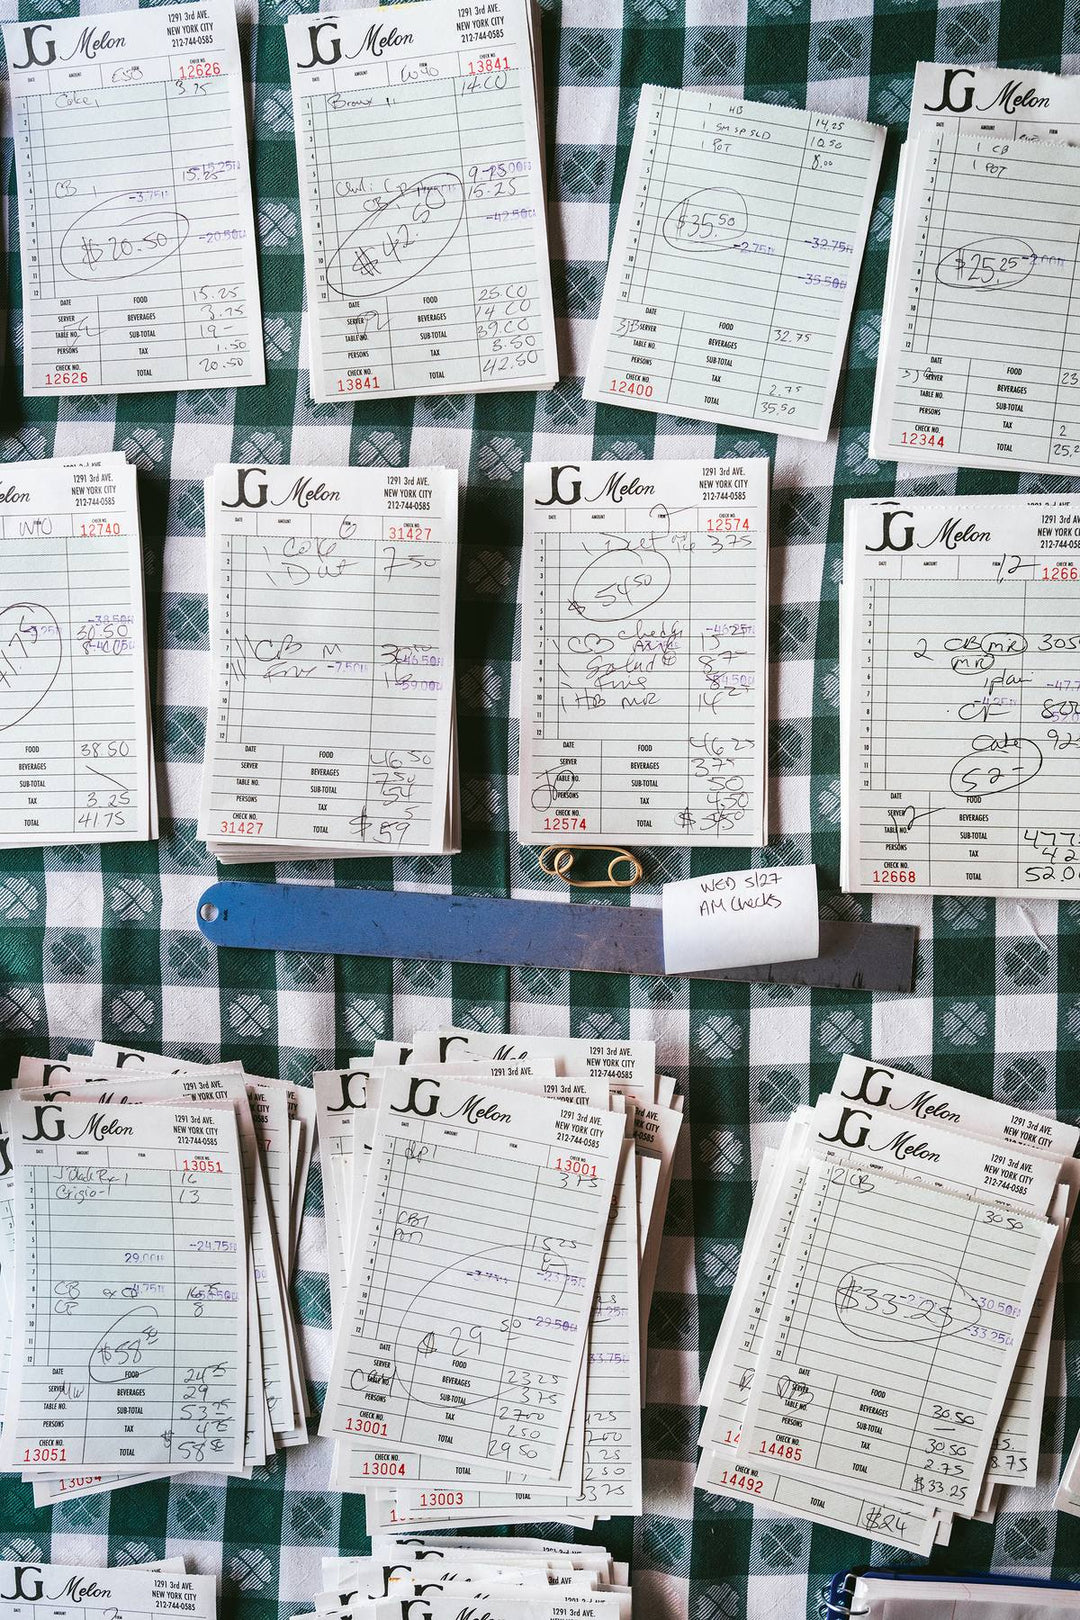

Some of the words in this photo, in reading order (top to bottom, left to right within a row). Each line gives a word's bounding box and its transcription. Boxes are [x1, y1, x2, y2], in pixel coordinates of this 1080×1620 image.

[168, 13, 182, 23] 1291
[184, 11, 195, 21] 3rd
[197, 10, 210, 19] AVE.
[458, 8, 472, 17] 1291
[475, 5, 485, 15] 3rd
[488, 4, 500, 13] AVE.
[167, 26, 180, 36] NEW
[182, 24, 199, 34] YORK
[200, 22, 213, 32] CITY
[456, 21, 470, 31] NEW
[472, 18, 489, 28] YORK
[491, 16, 504, 26] CITY
[172, 35, 213, 48] 212-744-0585
[461, 29, 504, 43] 212-744-0585
[13, 24, 56, 69] JG
[60, 27, 126, 61] Melon
[297, 23, 342, 68] JG
[345, 24, 414, 59] Melon
[179, 63, 221, 78] 12626
[468, 58, 510, 75] 13841
[924, 69, 976, 113] JG
[976, 80, 1050, 114] Melon
[134, 296, 148, 304] FOOD
[128, 313, 156, 322] BEVERAGES
[646, 307, 657, 315] DATE
[640, 322, 657, 332] SERVER
[719, 322, 734, 331] FOOD
[129, 330, 156, 338] SUB-TOTAL
[633, 339, 647, 348] TABLE
[708, 338, 737, 350] BEVERAGES
[631, 356, 652, 366] PERSONS
[706, 356, 732, 367] SUB-TOTAL
[45, 372, 88, 385] 12626
[626, 373, 641, 381] CHECK
[712, 374, 722, 382] TAX
[337, 377, 380, 393] 13841
[609, 380, 653, 398] 12400
[704, 396, 719, 405] TOTAL
[900, 432, 945, 448] 12344
[997, 443, 1012, 452] TOTAL
[74, 474, 87, 483] 1291
[90, 474, 99, 482] 3rd
[102, 473, 114, 482] AVE.
[703, 468, 716, 476] 1291
[720, 467, 730, 476] 3rd
[732, 467, 745, 476] AVE.
[222, 468, 268, 508] JG
[271, 476, 340, 508] Melon
[388, 476, 401, 484] 1291
[404, 477, 414, 486] 3rd
[416, 477, 429, 486] AVE.
[535, 465, 582, 506] JG
[584, 472, 655, 503] Melon
[699, 480, 714, 489] NEW
[715, 480, 732, 488] YORK
[734, 480, 748, 488] CITY
[72, 487, 85, 495] NEW
[86, 486, 102, 494] YORK
[104, 486, 116, 494] CITY
[384, 489, 398, 497] NEW
[400, 489, 416, 498] YORK
[419, 490, 432, 498] CITY
[703, 492, 746, 500] 212-744-0585
[76, 497, 115, 506] 212-744-0585
[388, 501, 430, 510] 212-744-0585
[81, 523, 120, 537] 12740
[707, 519, 749, 531] 12574
[865, 510, 915, 552] JG
[917, 518, 991, 550] Melon
[389, 528, 432, 541] 31427
[220, 821, 263, 835] 31427
[313, 826, 328, 834] TOTAL
[544, 818, 587, 831] 12574
[873, 870, 916, 884] 12668
[700, 877, 737, 895] WED
[700, 898, 727, 916] AM
[390, 1078, 440, 1117] JG
[440, 1094, 511, 1124] Melon
[840, 1066, 894, 1107] JG
[889, 1091, 960, 1123] Melon
[22, 1105, 66, 1141] JG
[68, 1113, 134, 1141] Melon
[175, 1115, 188, 1123] 1291
[191, 1116, 201, 1124] 3rd
[561, 1110, 574, 1120] 1291
[577, 1113, 588, 1122] 3rd
[589, 1116, 602, 1126] AVE.
[173, 1126, 186, 1134] NEW
[188, 1126, 204, 1134] YORK
[555, 1121, 570, 1130] NEW
[572, 1124, 588, 1134] YORK
[590, 1128, 604, 1138] CITY
[818, 1107, 872, 1148] JG
[868, 1131, 940, 1162] Melon
[178, 1136, 218, 1146] 212-744-0585
[557, 1132, 600, 1149] 212-744-0585
[183, 1159, 224, 1173] 13051
[556, 1157, 597, 1179] 13001
[991, 1154, 1006, 1164] 1291
[1008, 1159, 1020, 1169] 3rd
[1020, 1163, 1032, 1173] AVE.
[984, 1164, 1000, 1175] NEW
[1001, 1169, 1018, 1180] YORK
[1019, 1174, 1034, 1185] CITY
[984, 1176, 1028, 1195] 212-744-0585
[346, 1417, 388, 1437] 13001
[23, 1448, 67, 1462] 13051
[760, 1442, 803, 1462] 14485
[363, 1461, 406, 1477] 13004
[721, 1471, 764, 1494] 14492
[420, 1491, 463, 1506] 13003
[1, 1566, 44, 1601] JG
[46, 1576, 112, 1603] Melon
[154, 1580, 167, 1588] 1291
[170, 1581, 180, 1589] 3rd
[182, 1582, 194, 1590] AVE.
[152, 1590, 165, 1598] NEW
[166, 1592, 182, 1600] YORK
[184, 1593, 196, 1601] CITY
[156, 1600, 196, 1611] 212-744-0585
